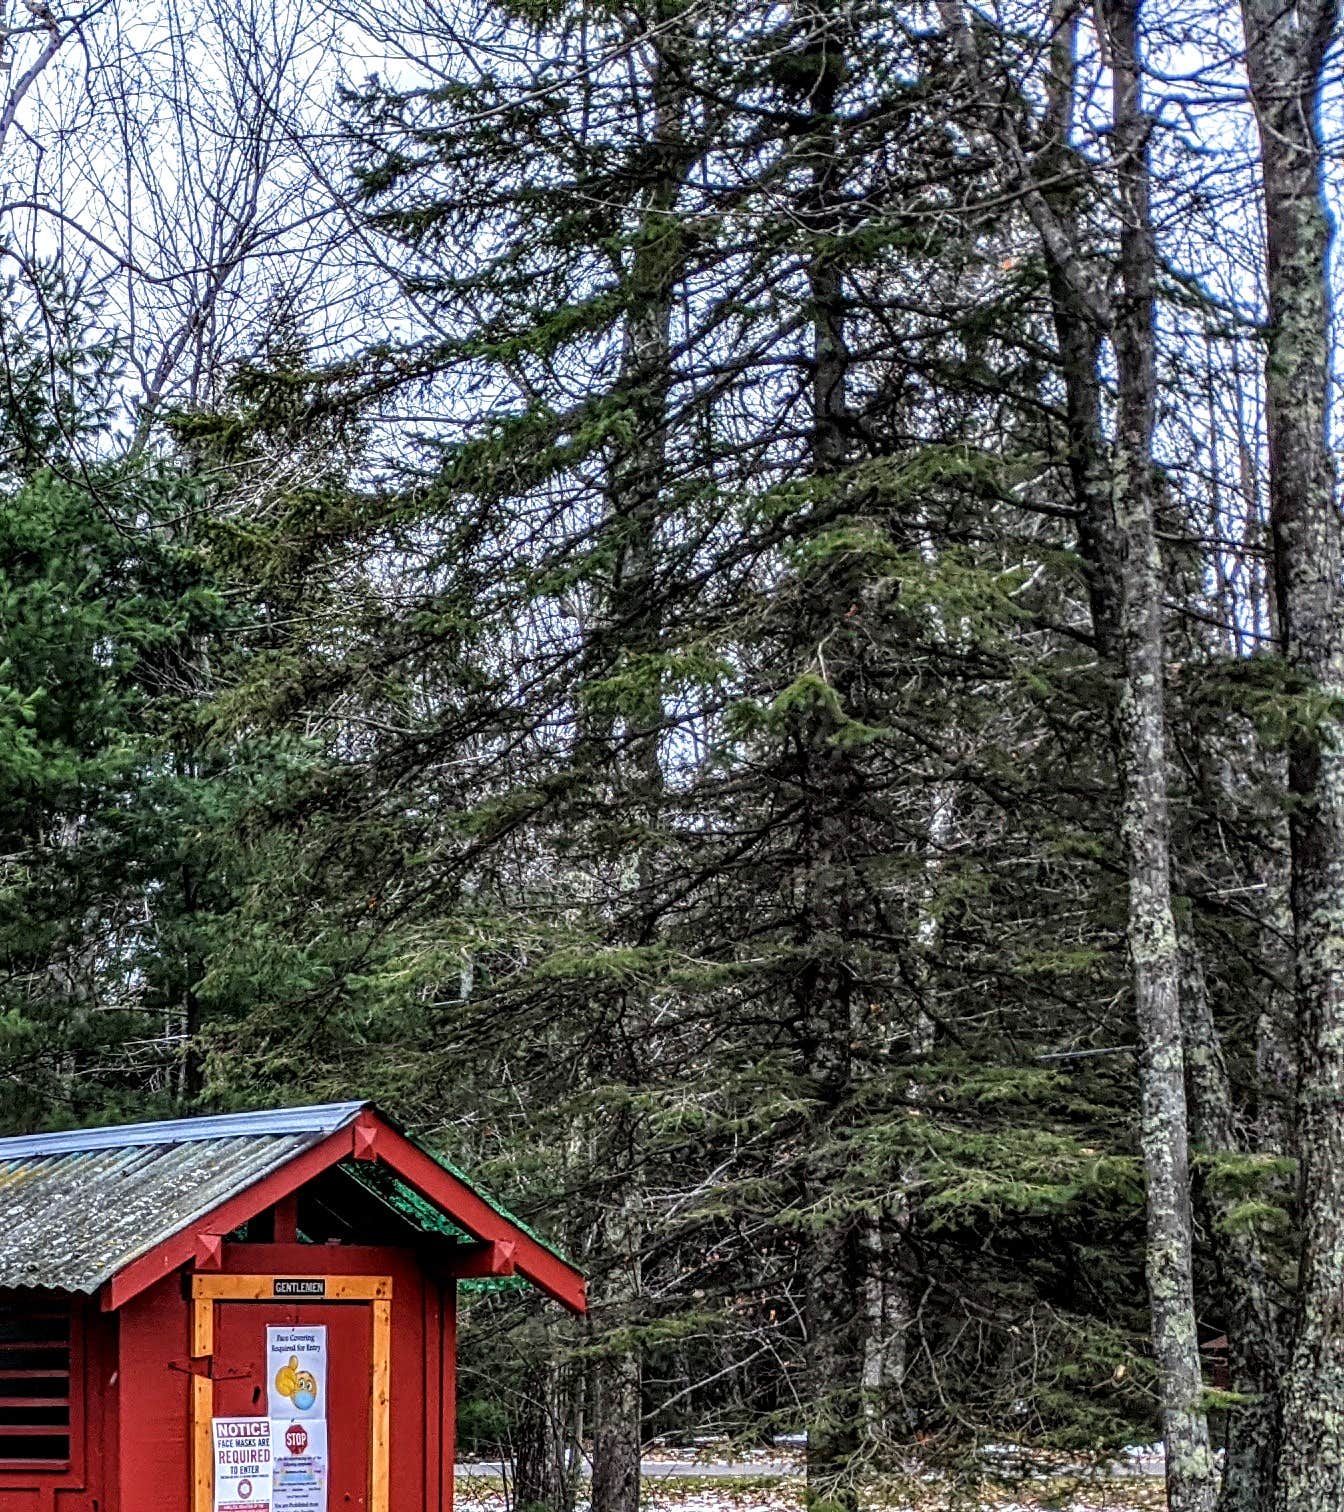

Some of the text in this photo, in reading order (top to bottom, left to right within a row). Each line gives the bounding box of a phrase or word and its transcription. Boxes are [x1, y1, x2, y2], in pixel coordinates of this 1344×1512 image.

[275, 1282, 324, 1293] GENTLEMEN
[217, 1422, 269, 1437] NOTICE
[218, 1437, 270, 1448] FACE MASKS ARE
[286, 1432, 307, 1446] STOP
[218, 1448, 270, 1465] REQUIRED
[230, 1464, 260, 1475] TO ENTER
